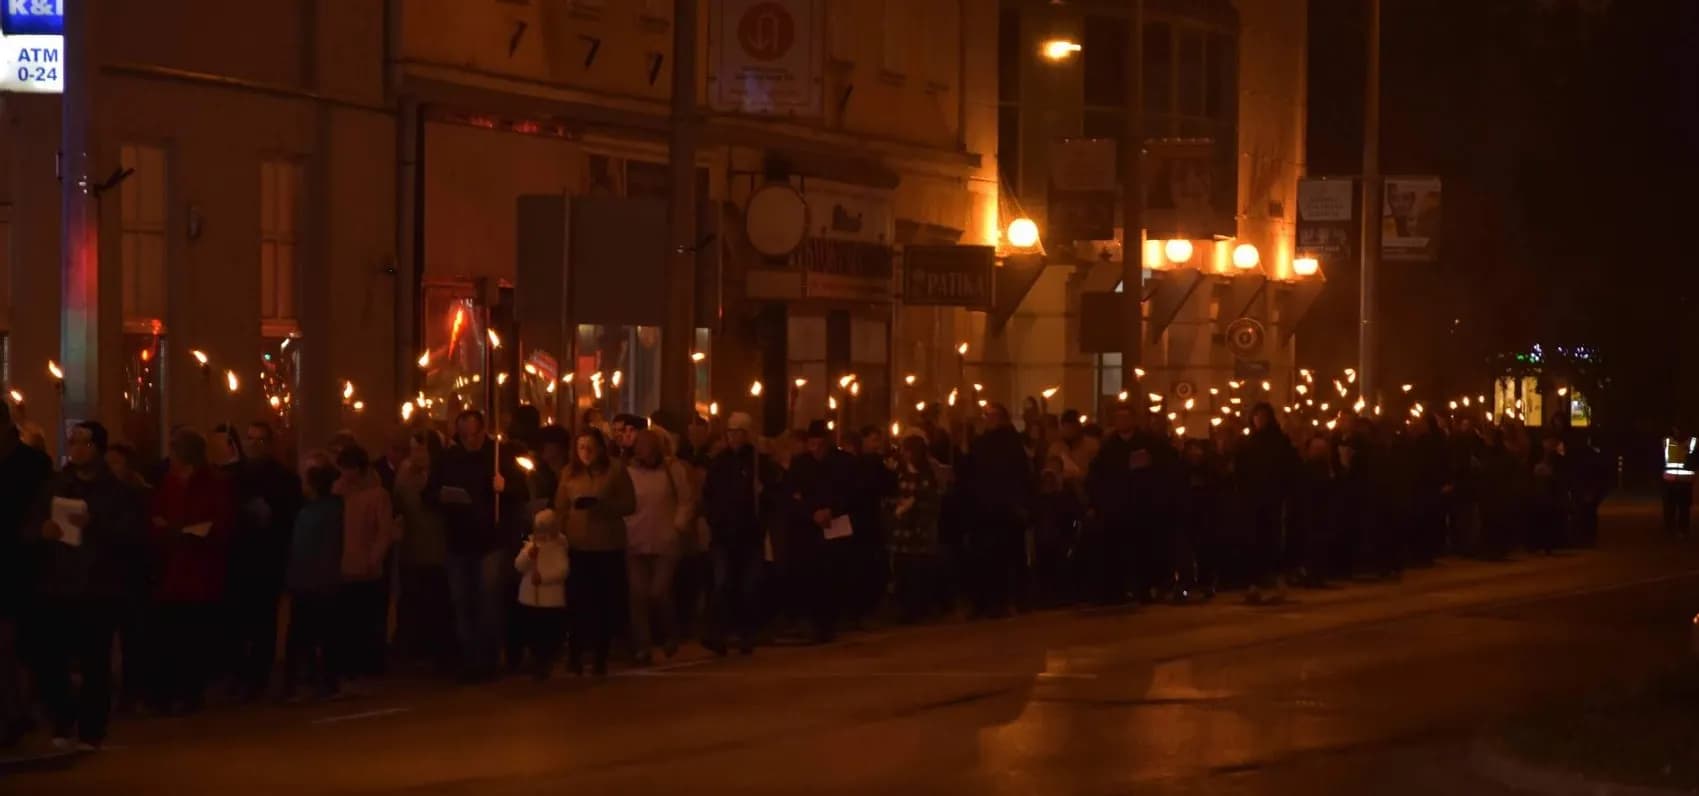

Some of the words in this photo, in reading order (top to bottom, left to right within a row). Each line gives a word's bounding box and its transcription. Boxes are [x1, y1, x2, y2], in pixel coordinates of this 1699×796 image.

[18, 47, 58, 62] ATM
[18, 66, 57, 82] 0-24
[928, 271, 985, 297] PATIKA
